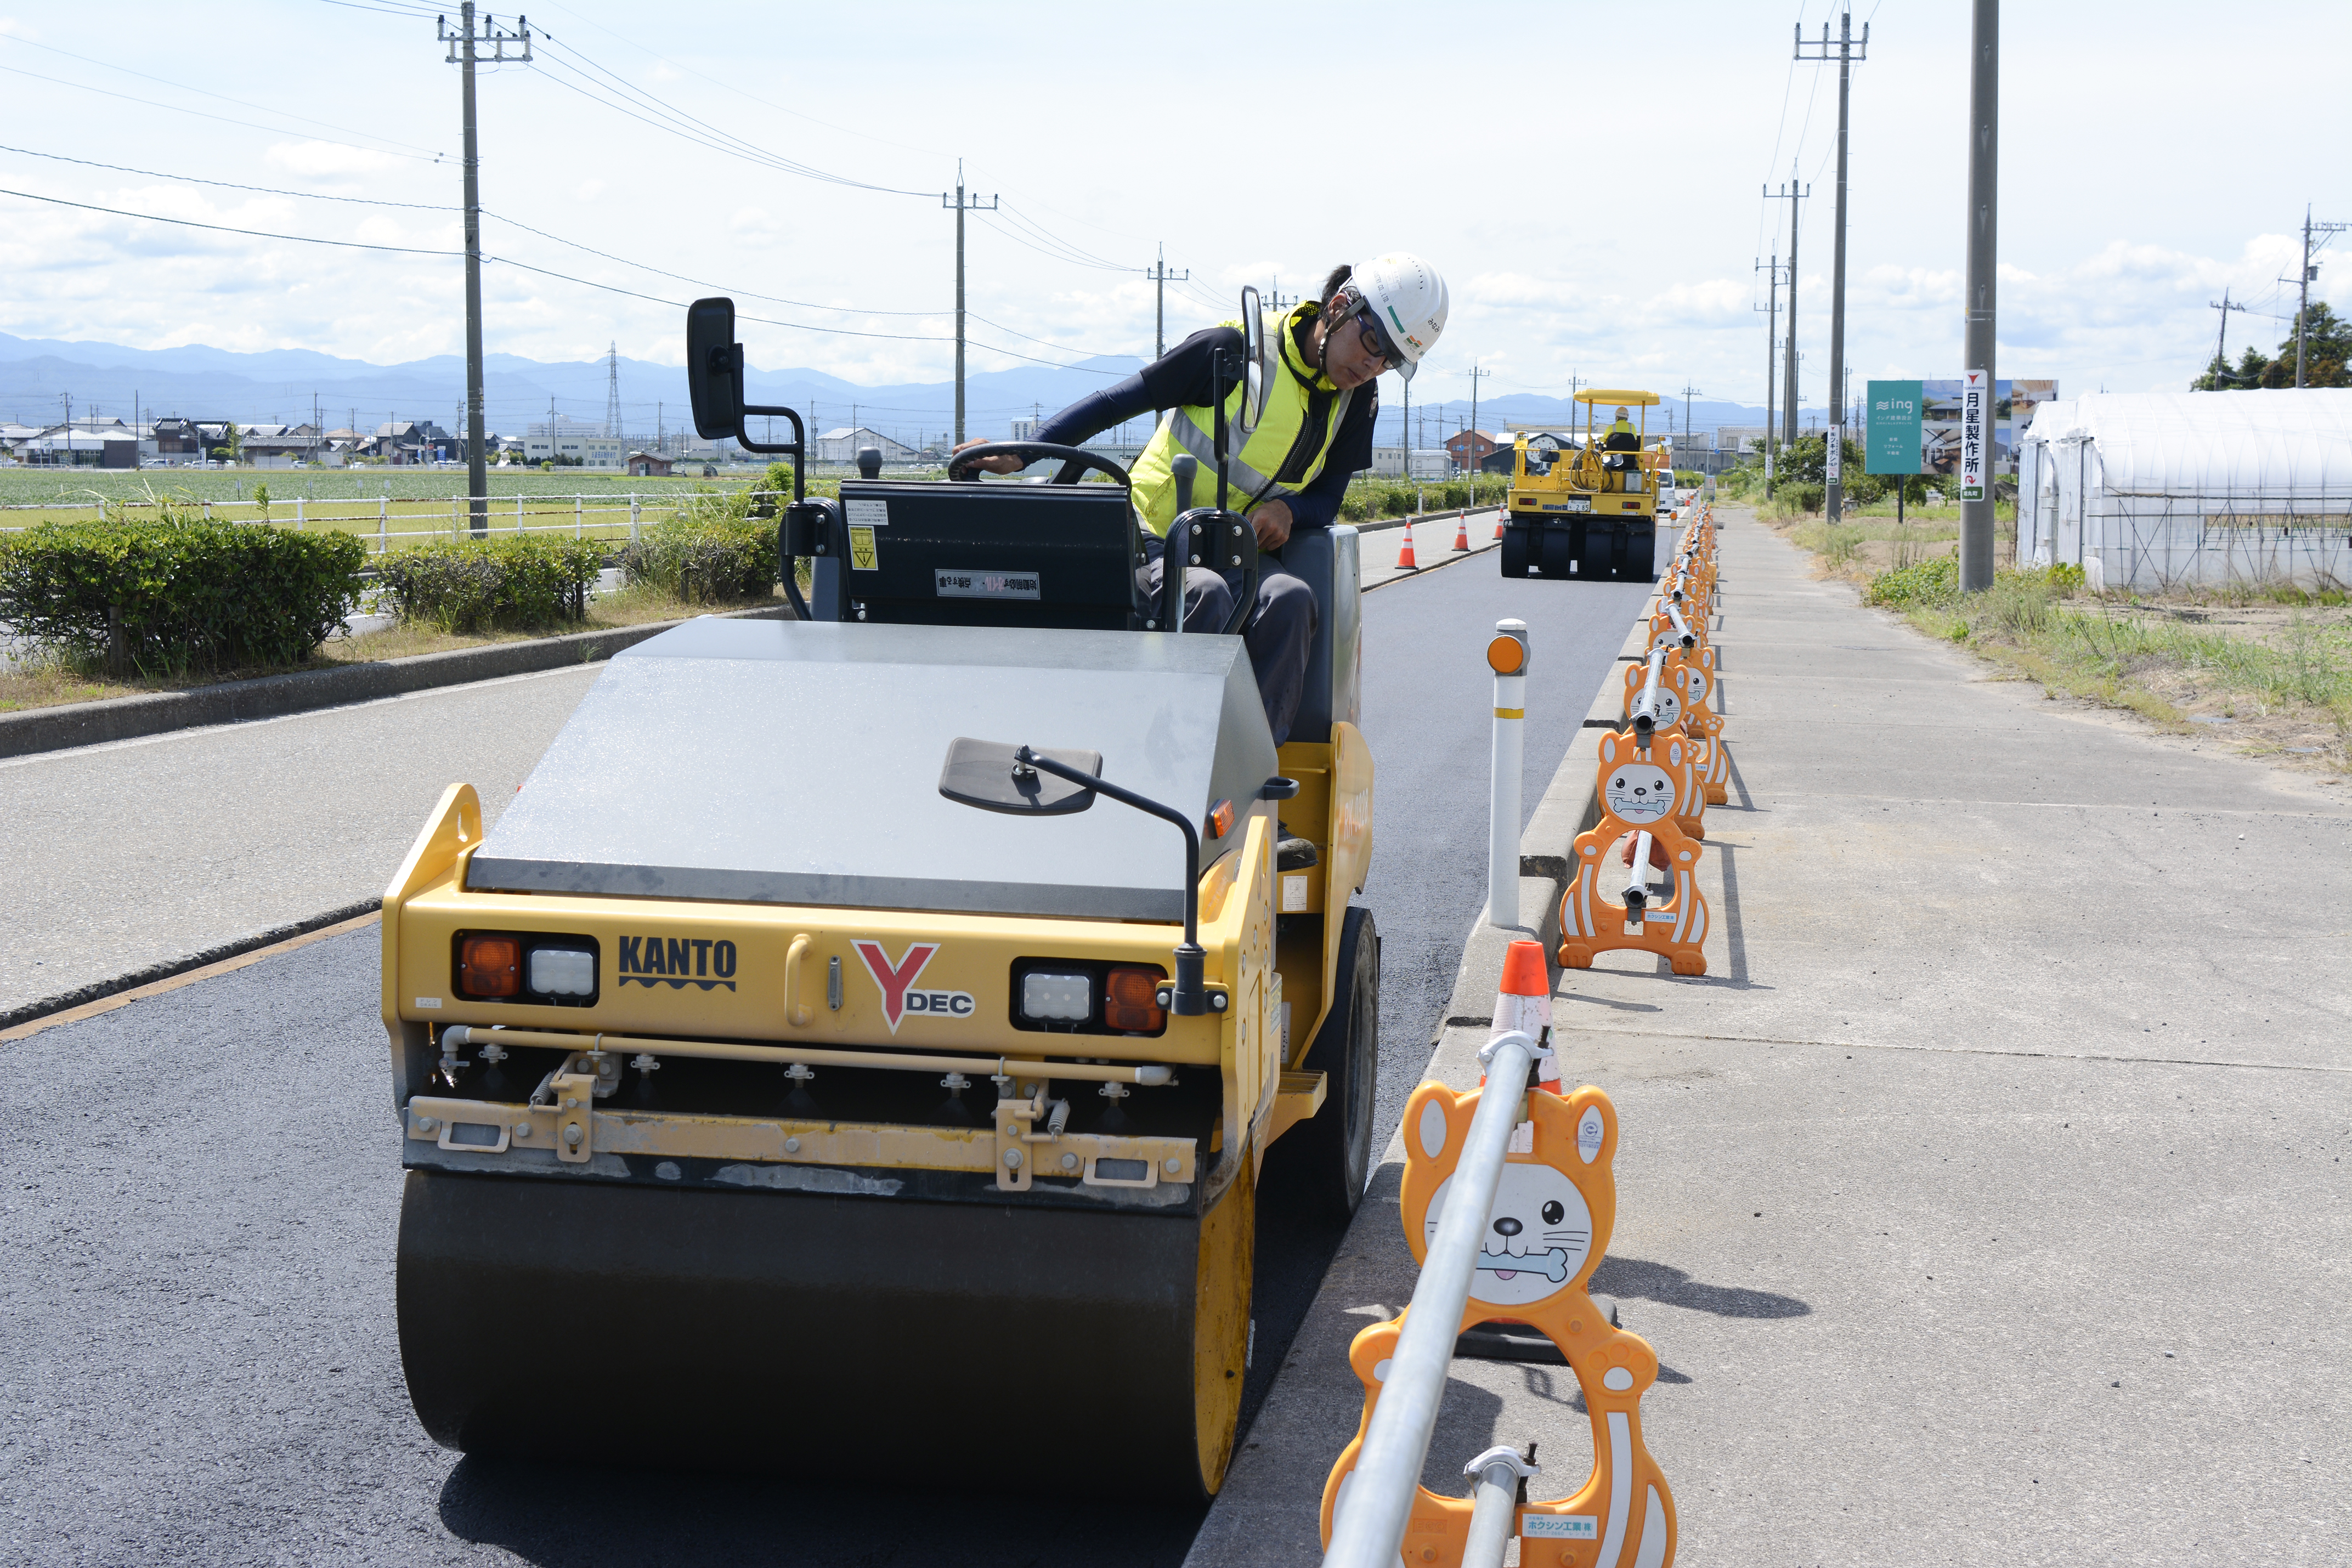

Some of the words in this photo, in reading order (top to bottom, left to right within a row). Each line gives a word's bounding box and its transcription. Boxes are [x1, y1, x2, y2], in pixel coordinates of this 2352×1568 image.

[1428, 318, 1440, 332] みなみ
[1891, 398, 1913, 414] ing
[1964, 393, 1980, 473] 月星製作所
[619, 936, 737, 978] KANTO
[906, 993, 973, 1014] DEC
[1417, 1522, 1444, 1530] ECO
